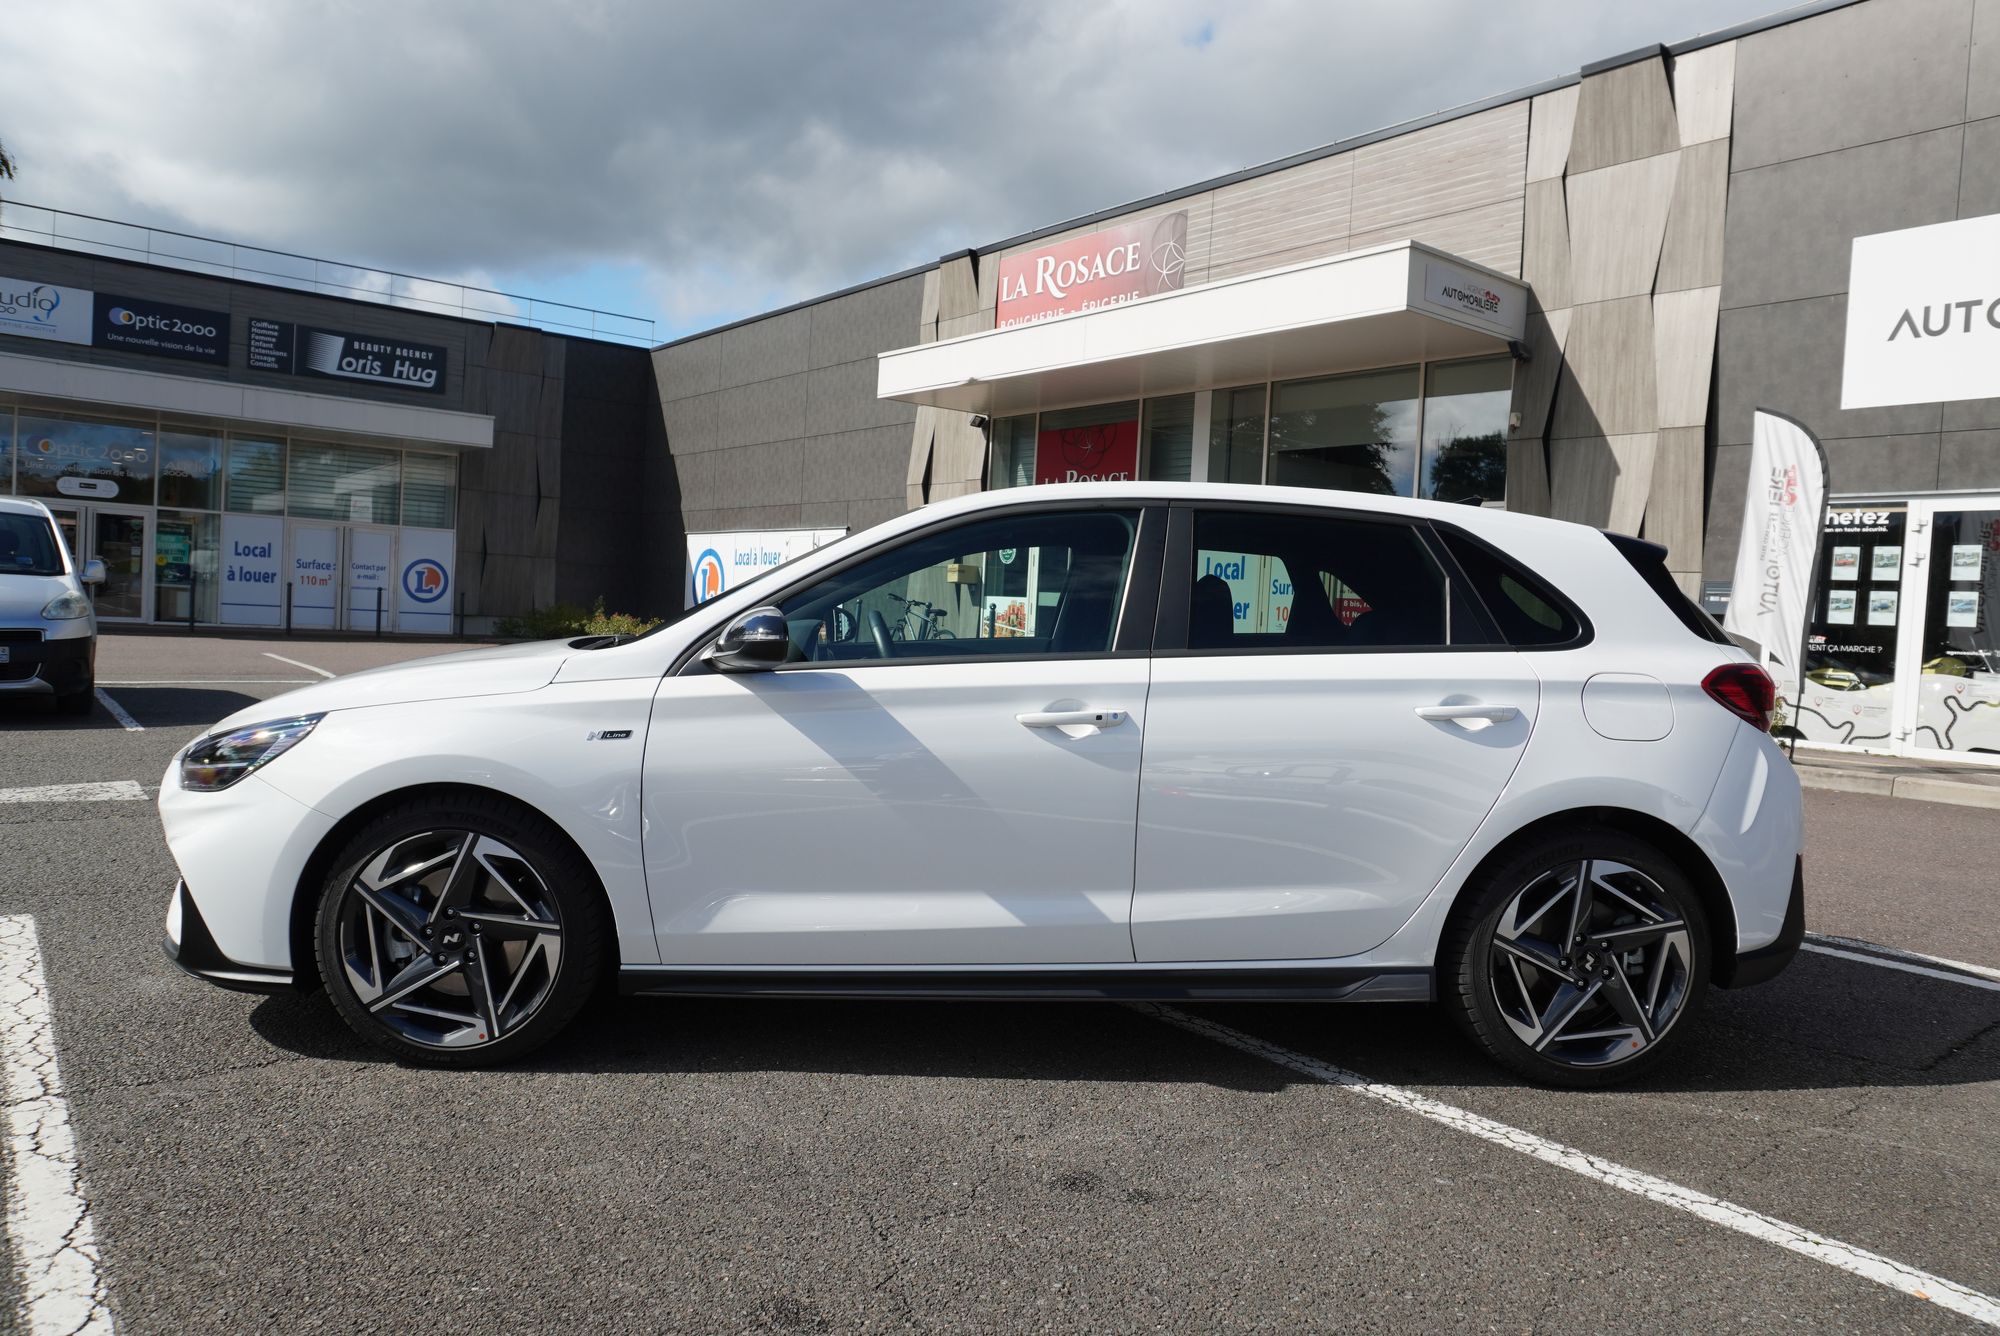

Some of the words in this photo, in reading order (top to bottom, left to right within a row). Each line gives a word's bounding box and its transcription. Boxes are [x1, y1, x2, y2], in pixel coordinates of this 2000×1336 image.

[1002, 273, 1029, 302] LA
[1034, 242, 1141, 299] ROSACE
[119, 310, 171, 331] Optic
[251, 320, 279, 330] Coiffure
[251, 327, 278, 336] Homme
[251, 333, 277, 343] Femme
[107, 333, 125, 342] Une
[125, 335, 160, 347] nouvelle
[161, 341, 183, 350] vision
[184, 344, 195, 353] de
[196, 345, 203, 353] la
[204, 347, 216, 355] vie
[251, 340, 274, 349] Enfant
[250, 346, 288, 357] Extensions
[353, 341, 391, 354] BEAUTY
[395, 347, 433, 360] AGENCY
[250, 353, 276, 362] Lissage
[250, 360, 279, 369] Conseils
[392, 359, 438, 387] Hug
[234, 541, 272, 558] Local
[735, 547, 752, 566] Local
[760, 547, 781, 566] louer
[296, 558, 332, 571] Surface
[351, 562, 373, 572] Contact
[374, 564, 387, 573] par
[226, 566, 236, 582] à
[239, 565, 277, 584] louer
[300, 574, 317, 586] 110
[356, 573, 376, 581] e-mail
[1840, 645, 1876, 653] MARCHE
